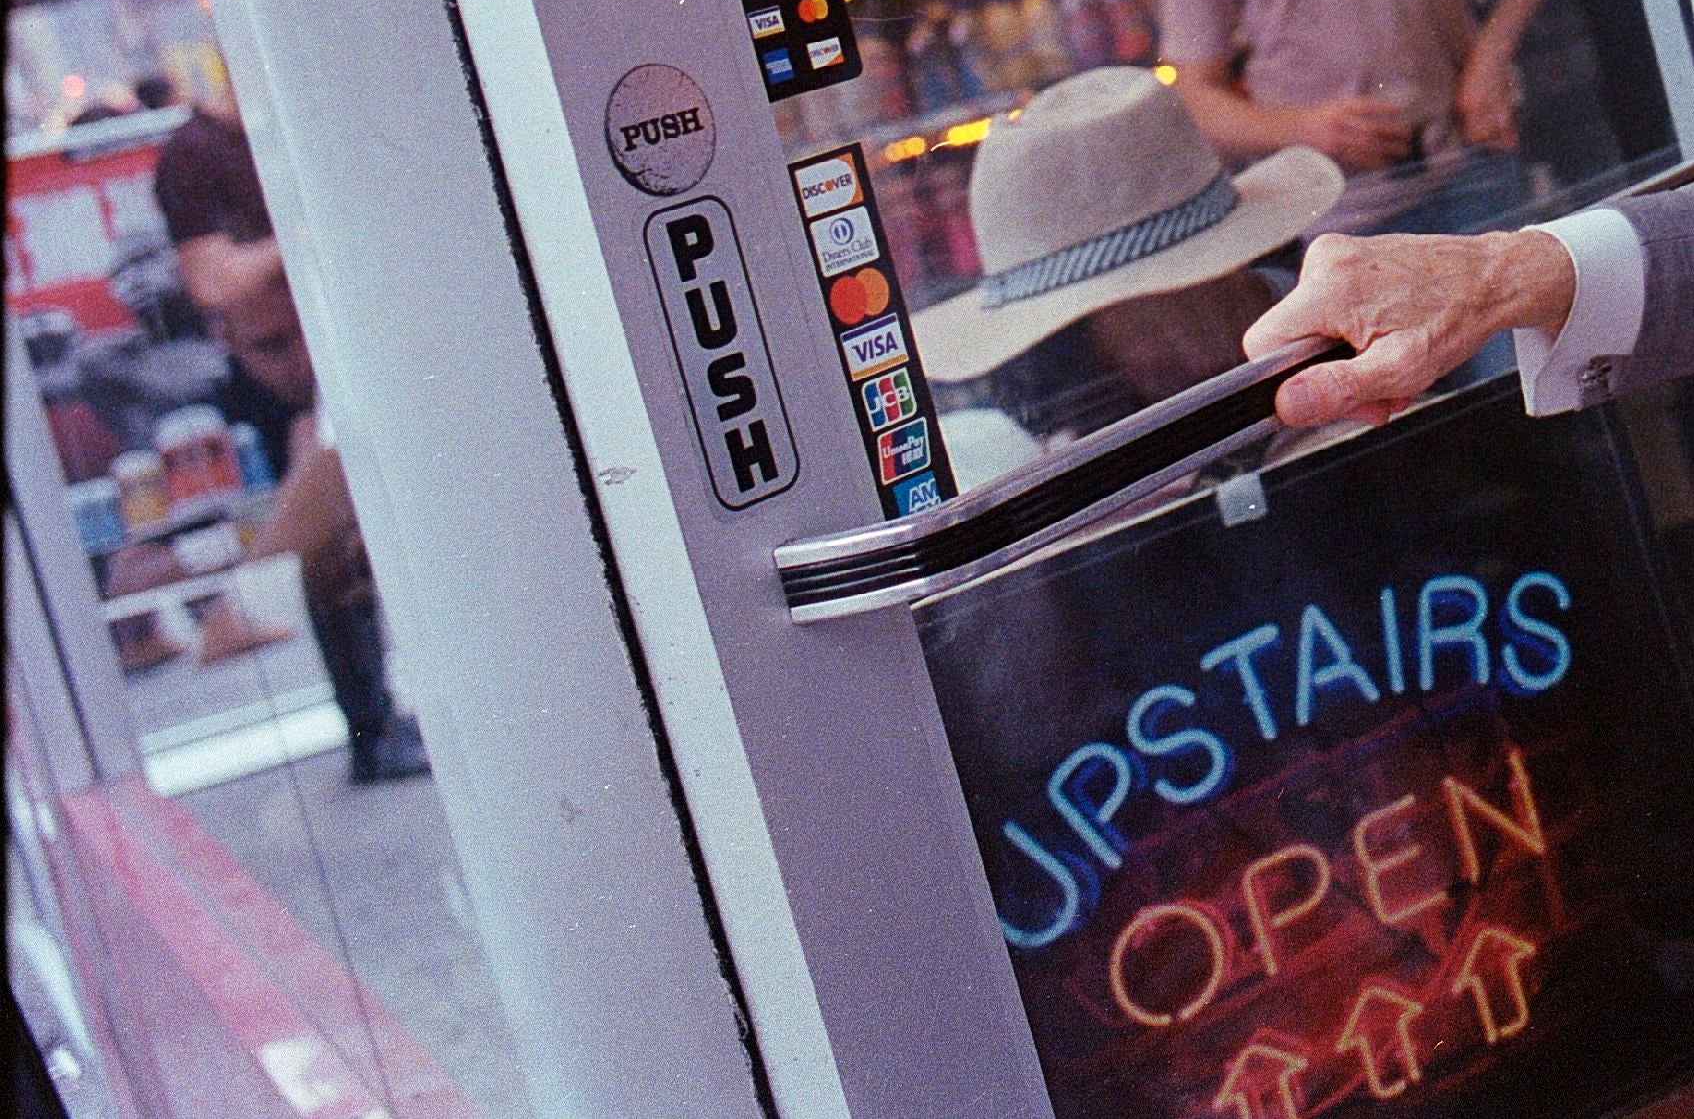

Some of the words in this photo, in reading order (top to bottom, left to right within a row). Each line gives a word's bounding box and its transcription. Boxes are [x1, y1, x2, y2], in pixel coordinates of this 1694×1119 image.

[755, 15, 780, 30] VISA
[621, 108, 704, 152] PUSH
[802, 173, 853, 200] DISCOVER
[666, 214, 779, 493] PUSH
[852, 331, 898, 363] VISA
[870, 386, 910, 414] JCB
[1109, 748, 1546, 1026] OPEN
